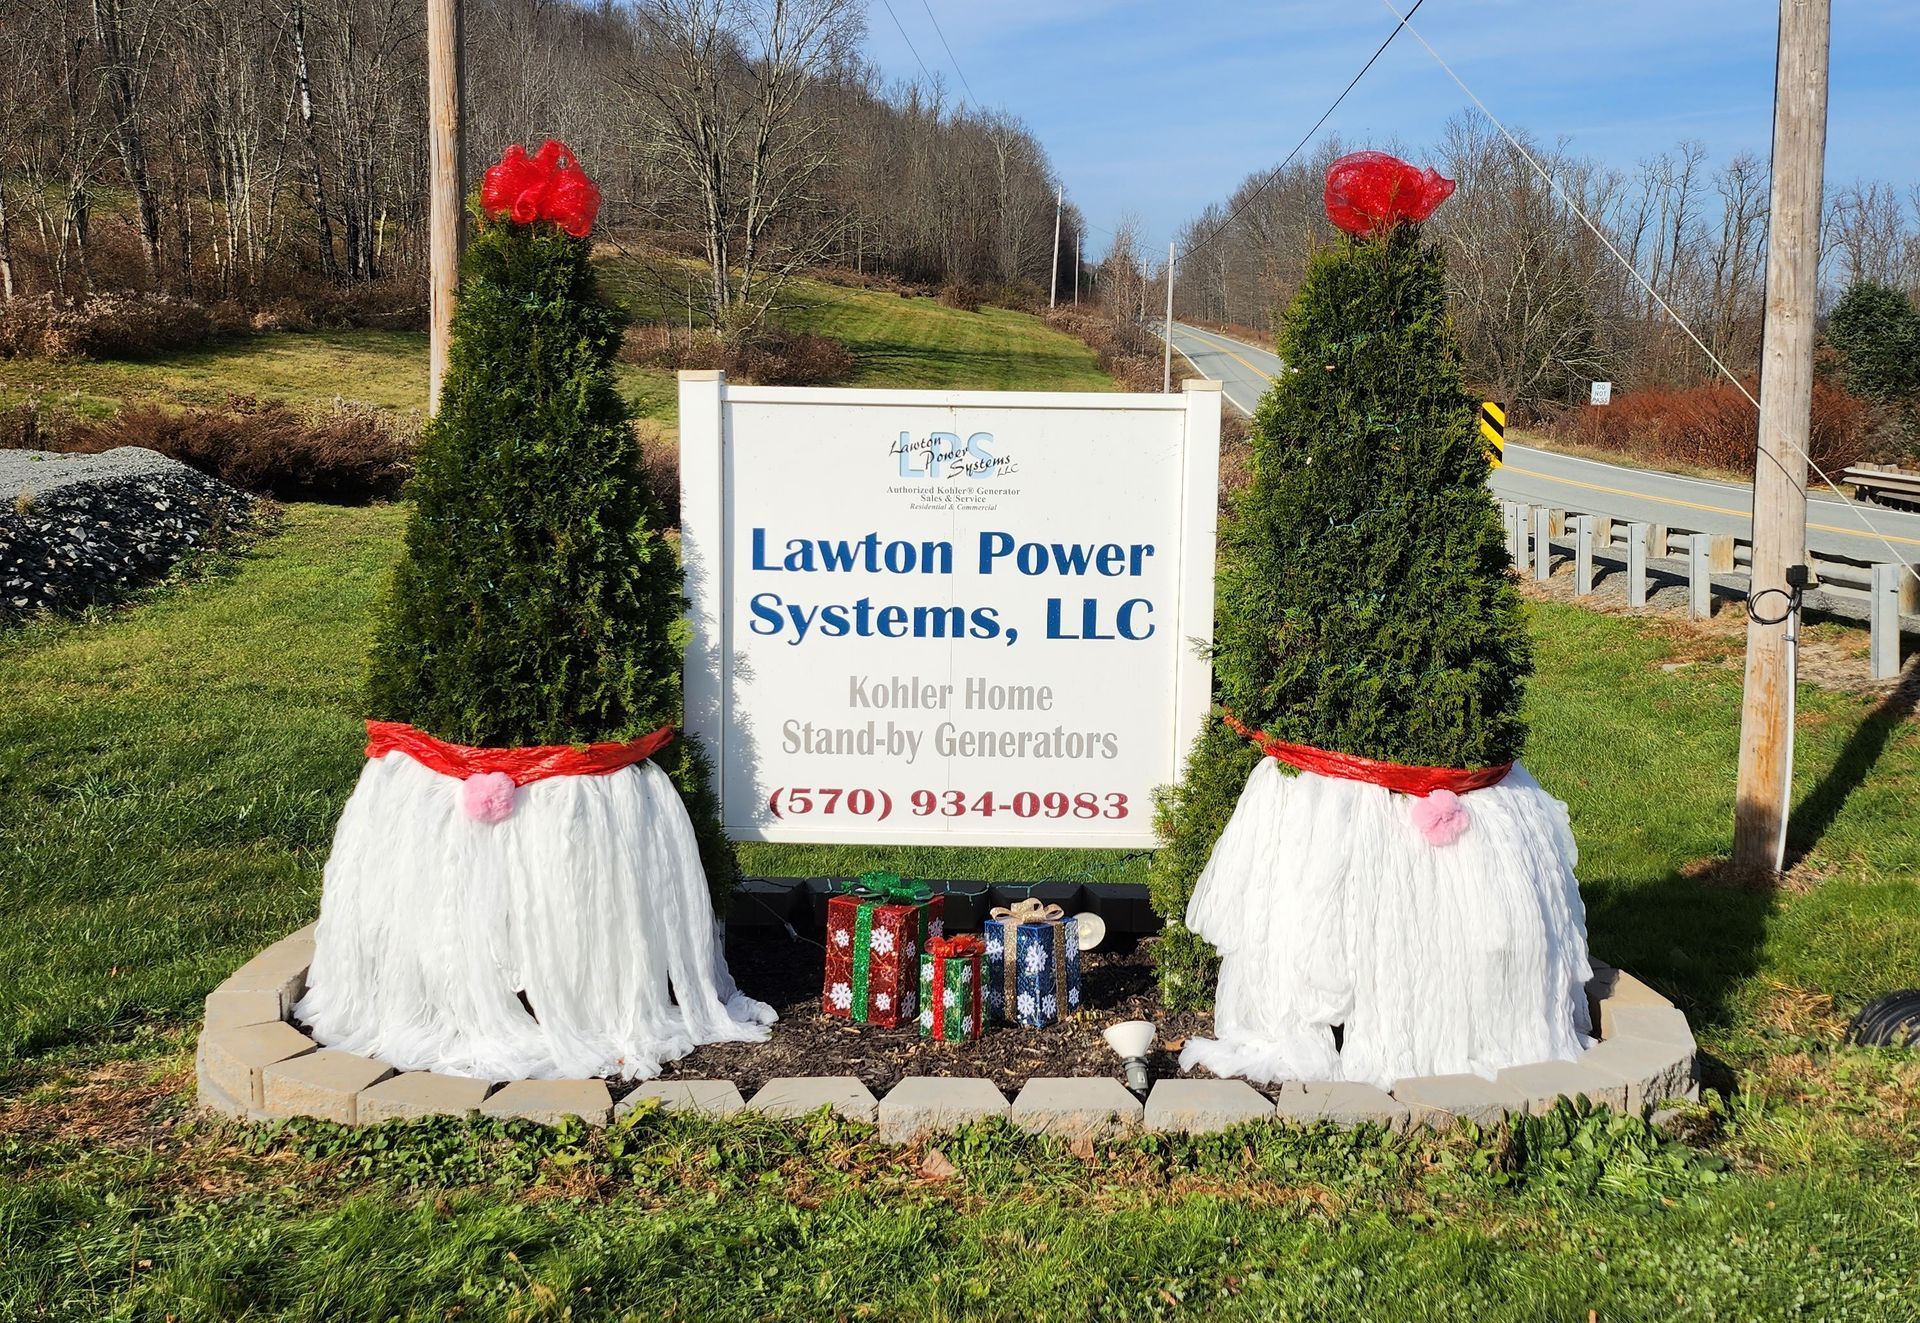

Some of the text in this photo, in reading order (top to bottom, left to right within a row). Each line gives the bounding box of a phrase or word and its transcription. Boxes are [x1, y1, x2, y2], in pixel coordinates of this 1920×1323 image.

[888, 437, 942, 456] Lawton
[919, 447, 968, 470] Power
[947, 455, 1011, 479] Systems
[996, 463, 1020, 478] LLC
[886, 486, 934, 494] Authorized
[976, 487, 1021, 496] Generator
[955, 495, 987, 503] Service
[752, 527, 1155, 577] Lawton Power
[749, 593, 1155, 646] Systems, LLC
[849, 675, 1053, 711] Kohler Home
[782, 719, 1119, 764] Stand-by Generators
[769, 787, 1129, 822] (570) 934-0983
